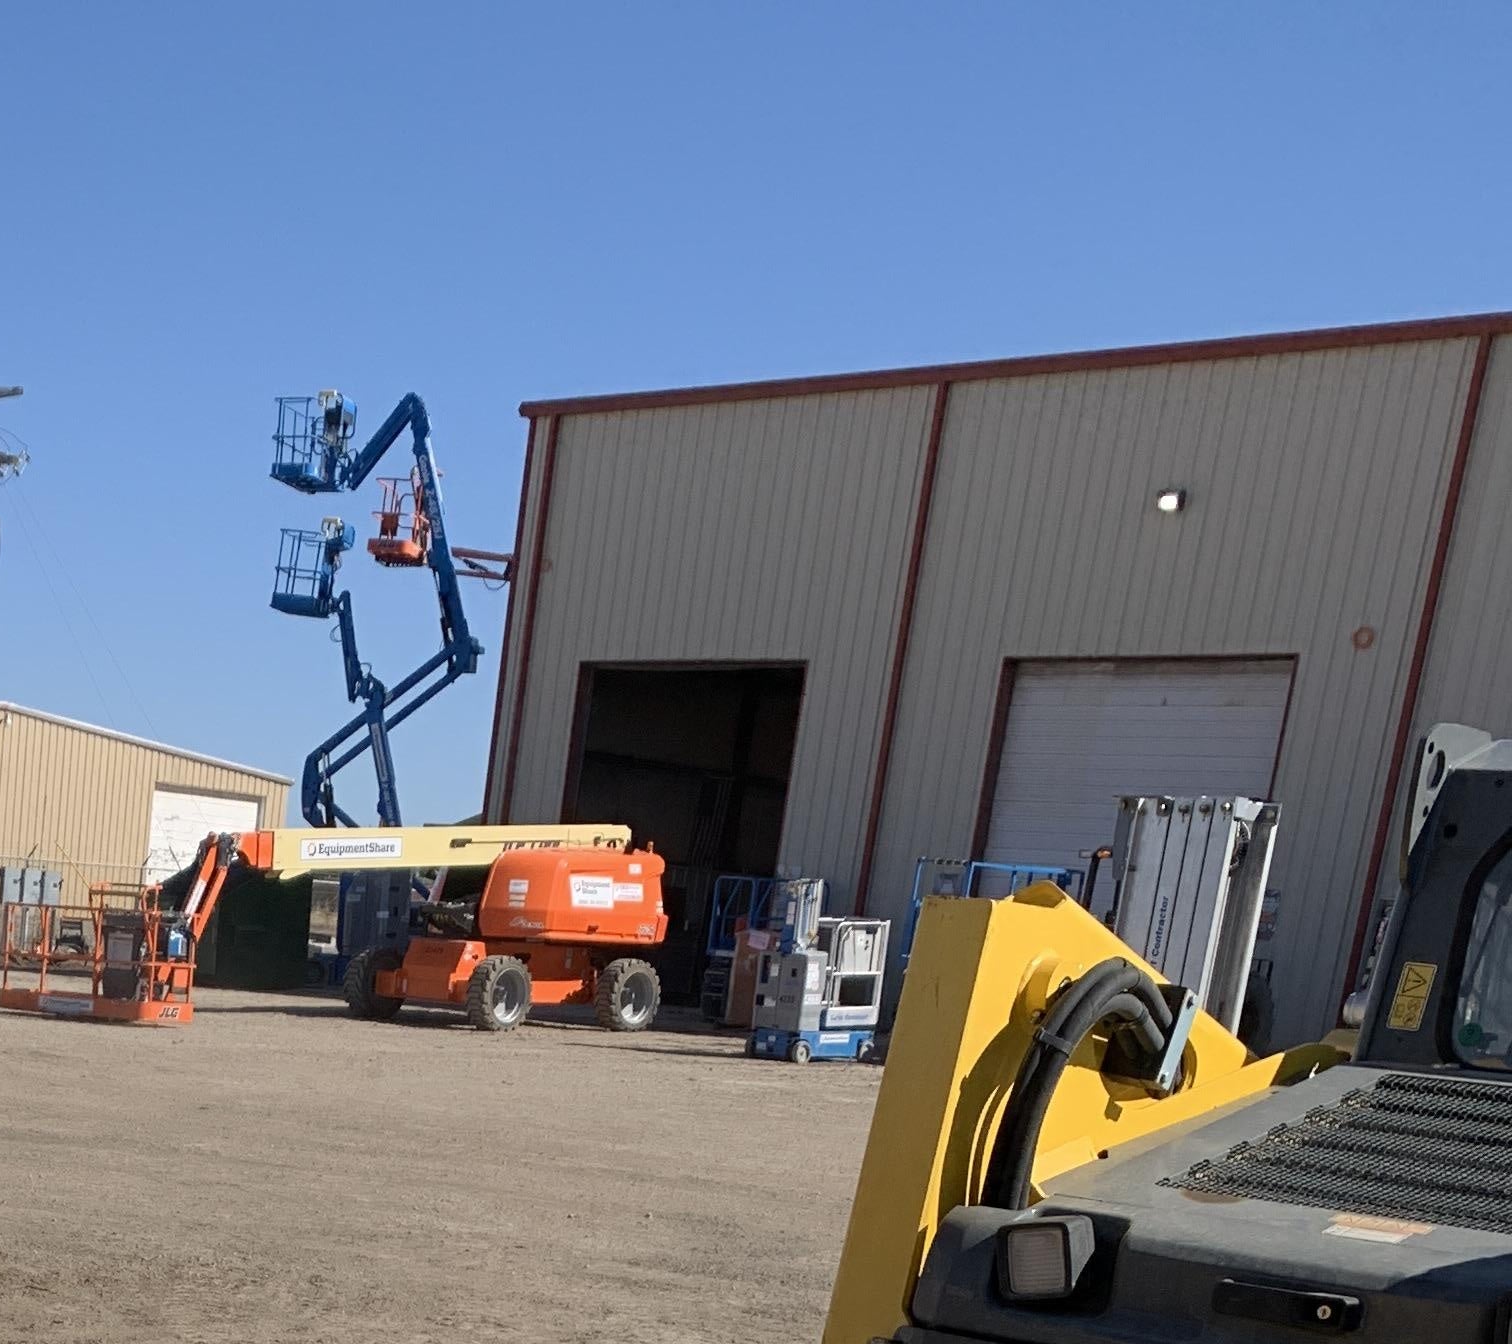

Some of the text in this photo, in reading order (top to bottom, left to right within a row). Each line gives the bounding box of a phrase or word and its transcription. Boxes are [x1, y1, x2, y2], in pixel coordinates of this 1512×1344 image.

[317, 842, 396, 856] EquipmentShare
[1151, 896, 1169, 957] Contractor
[158, 1006, 180, 1018] JLG
